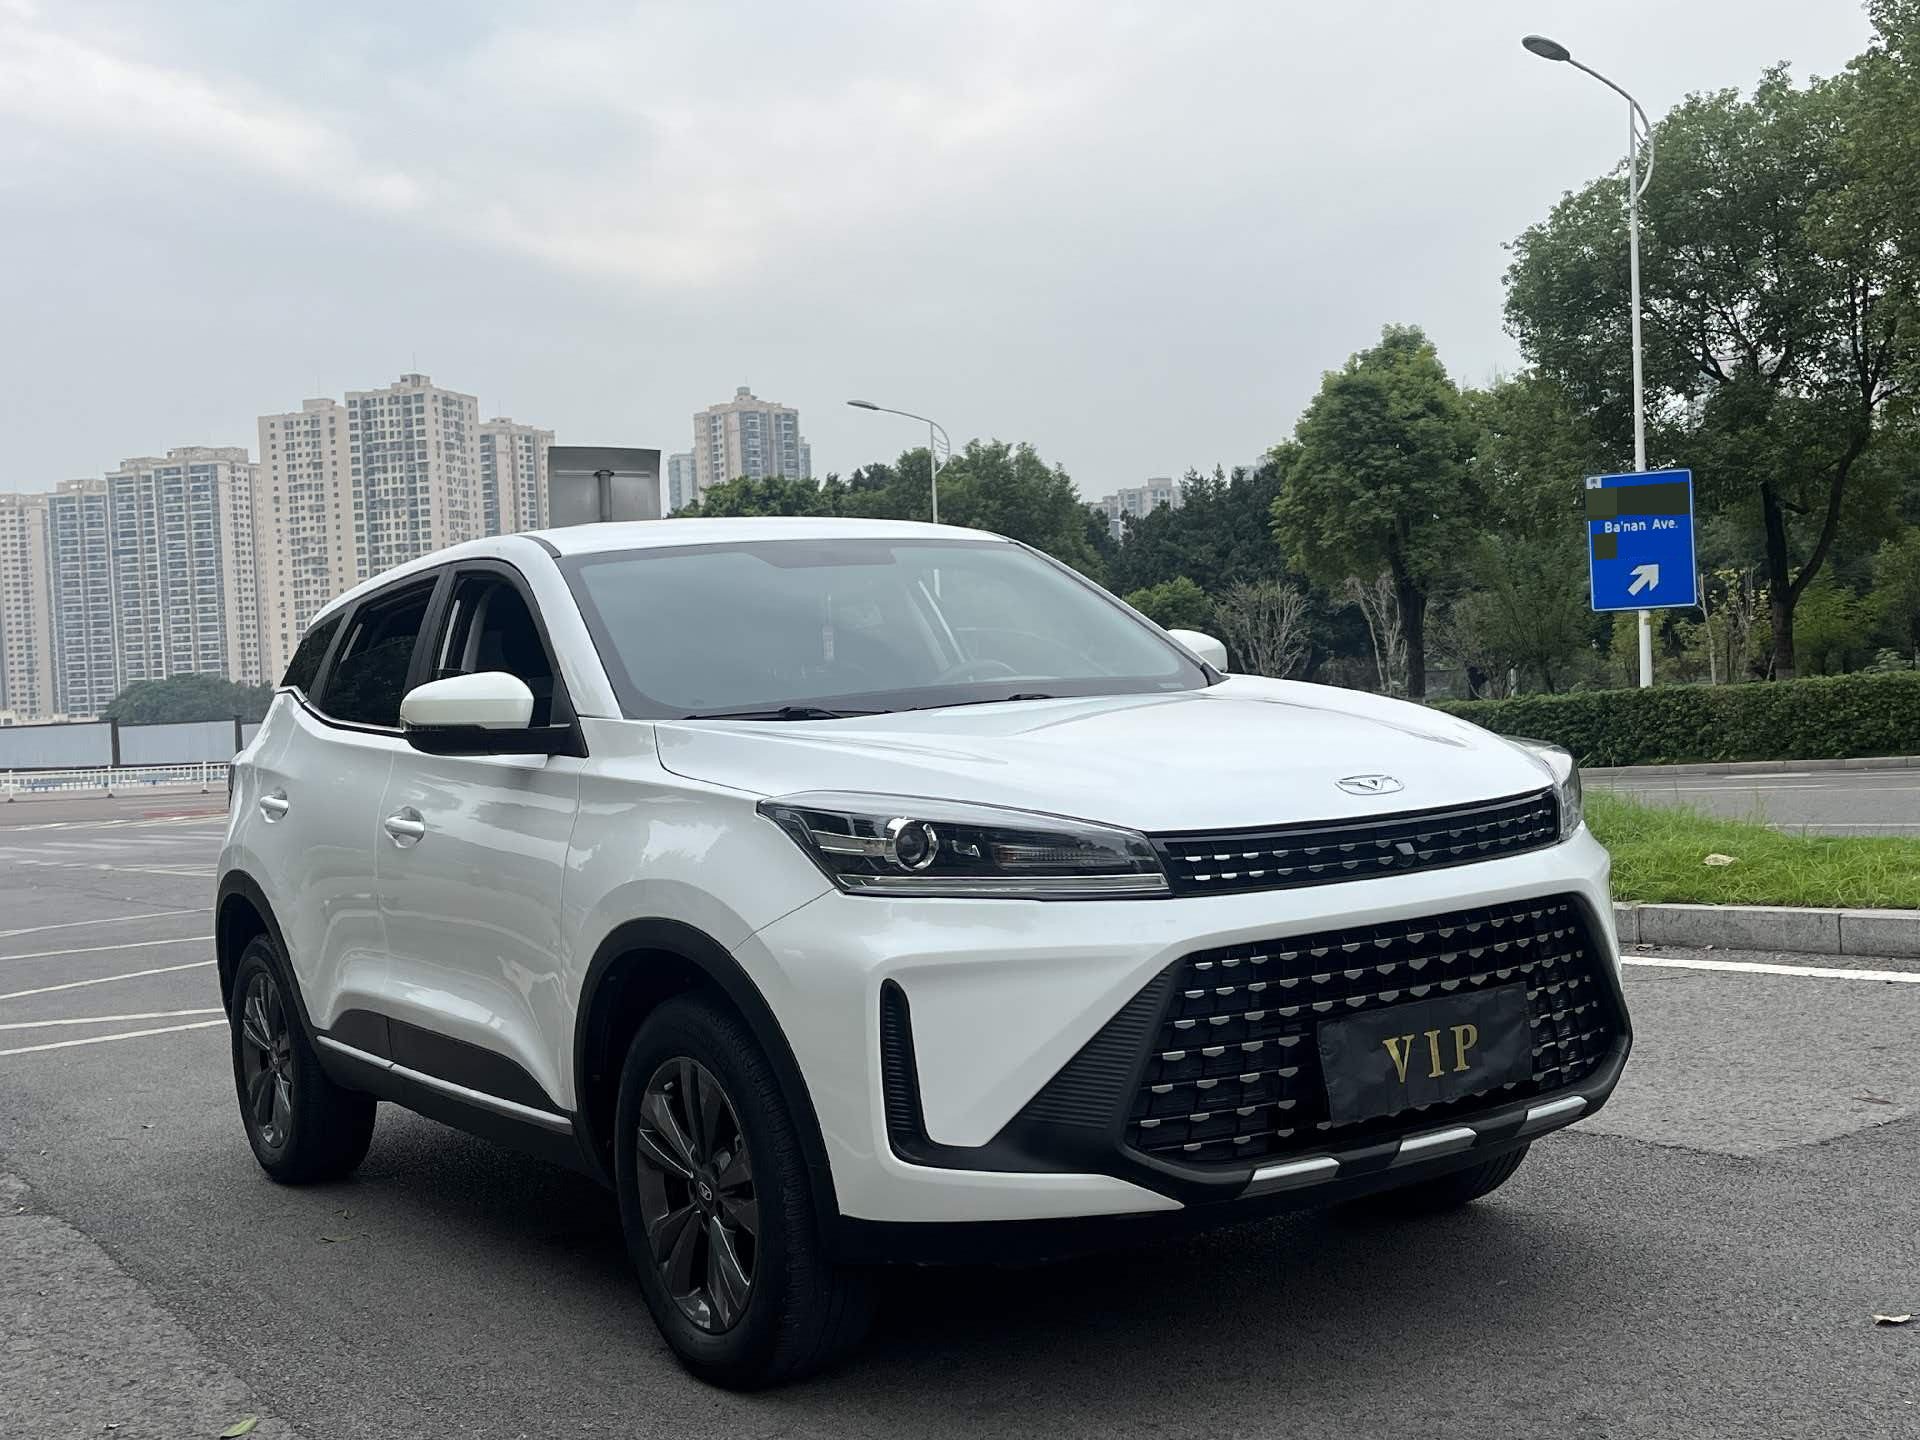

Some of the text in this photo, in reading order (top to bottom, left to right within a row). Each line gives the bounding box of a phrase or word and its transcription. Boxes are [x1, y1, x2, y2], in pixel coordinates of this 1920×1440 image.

[1604, 518, 1678, 533] Ba'nan Ave.
[1383, 1024, 1478, 1083] VIP
